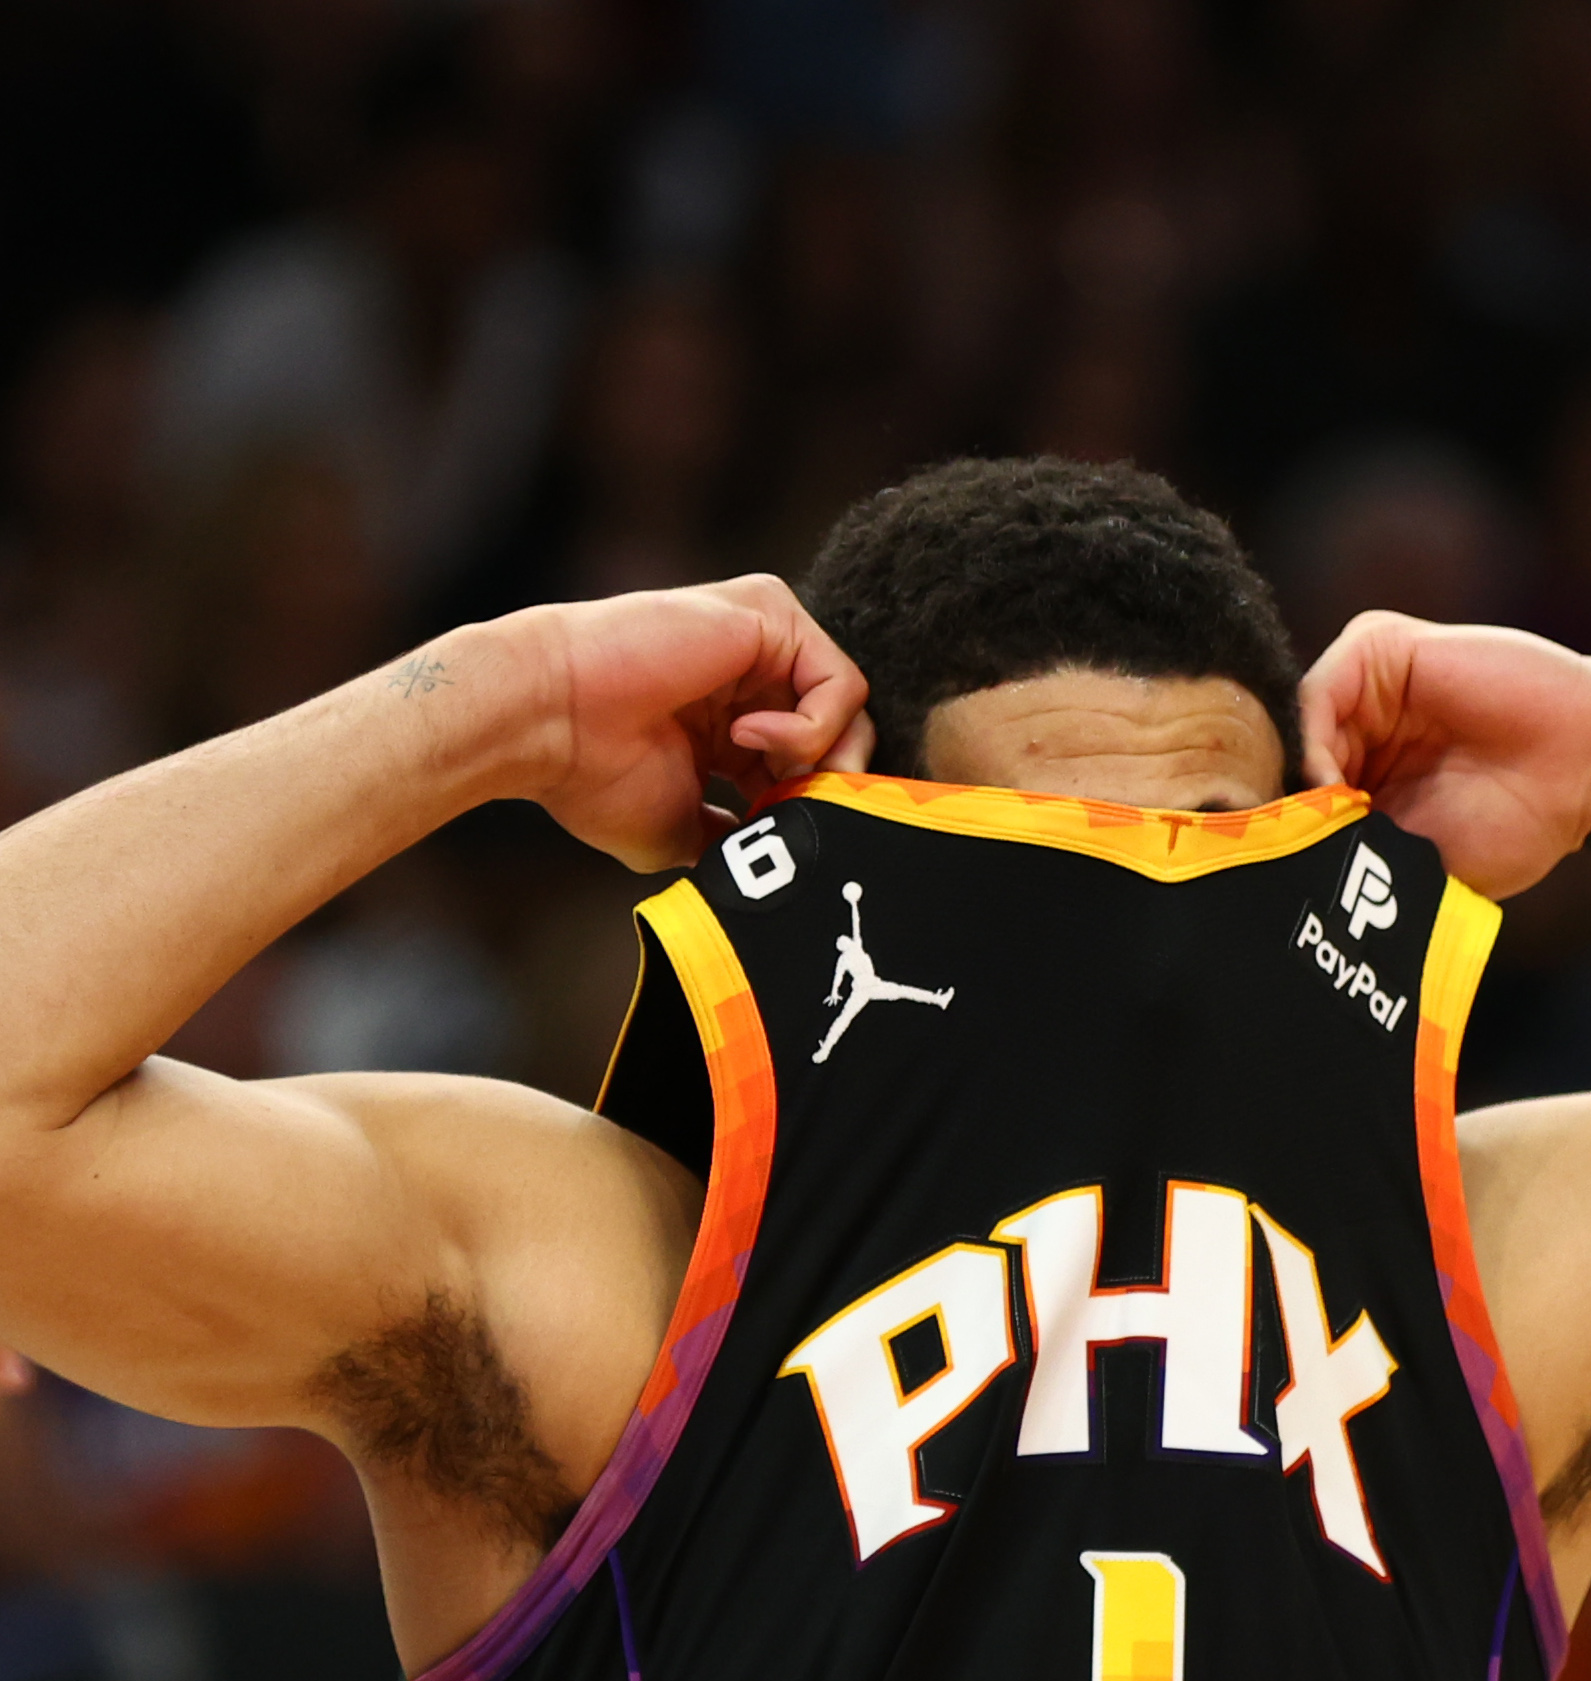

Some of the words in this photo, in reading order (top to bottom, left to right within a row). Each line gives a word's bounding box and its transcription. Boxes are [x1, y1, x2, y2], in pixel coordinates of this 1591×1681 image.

[721, 816, 796, 900] 6
[1296, 911, 1408, 1033] PayPal
[776, 1183, 1399, 1583] PHX
